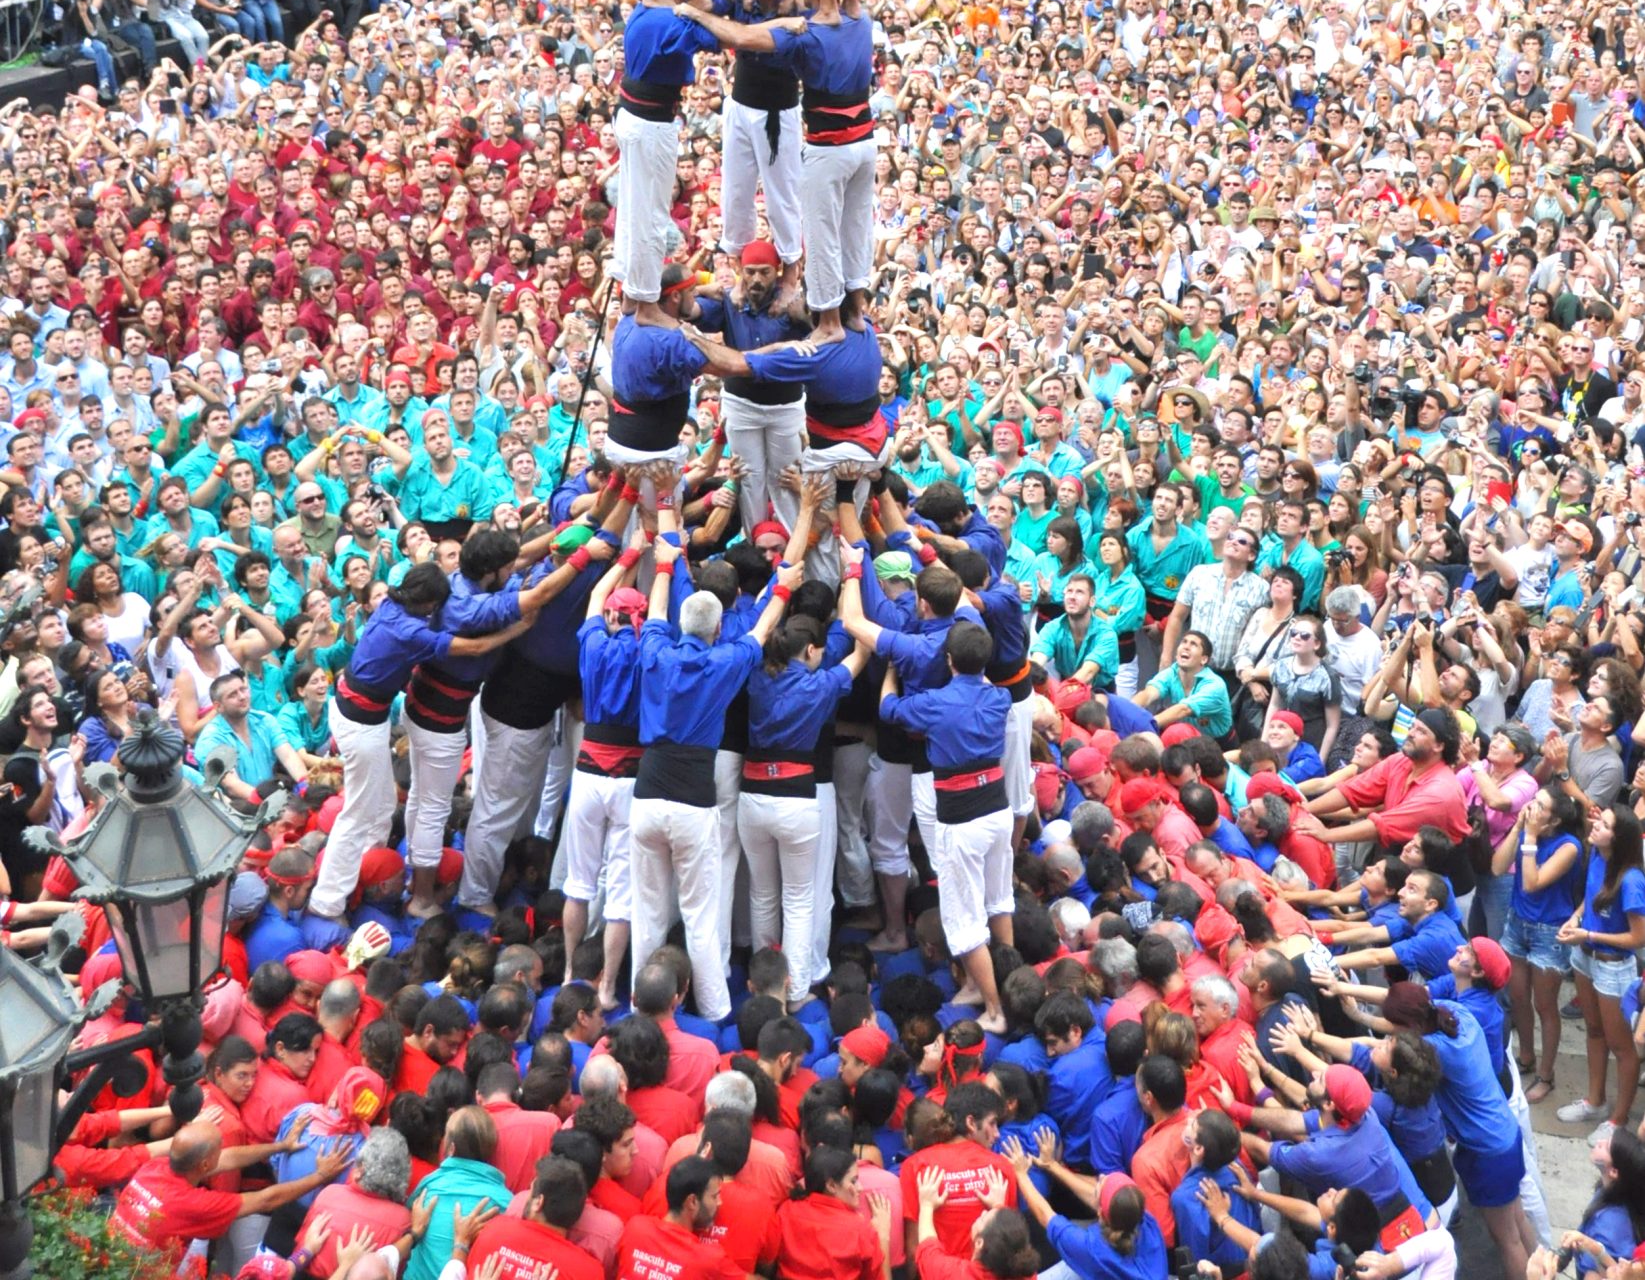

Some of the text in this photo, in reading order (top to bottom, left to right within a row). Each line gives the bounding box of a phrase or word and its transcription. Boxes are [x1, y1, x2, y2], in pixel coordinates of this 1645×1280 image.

[711, 1225, 728, 1236] per
[499, 1245, 535, 1267] nascuts
[633, 1248, 683, 1274] nascuts per
[633, 1260, 647, 1275] fer
